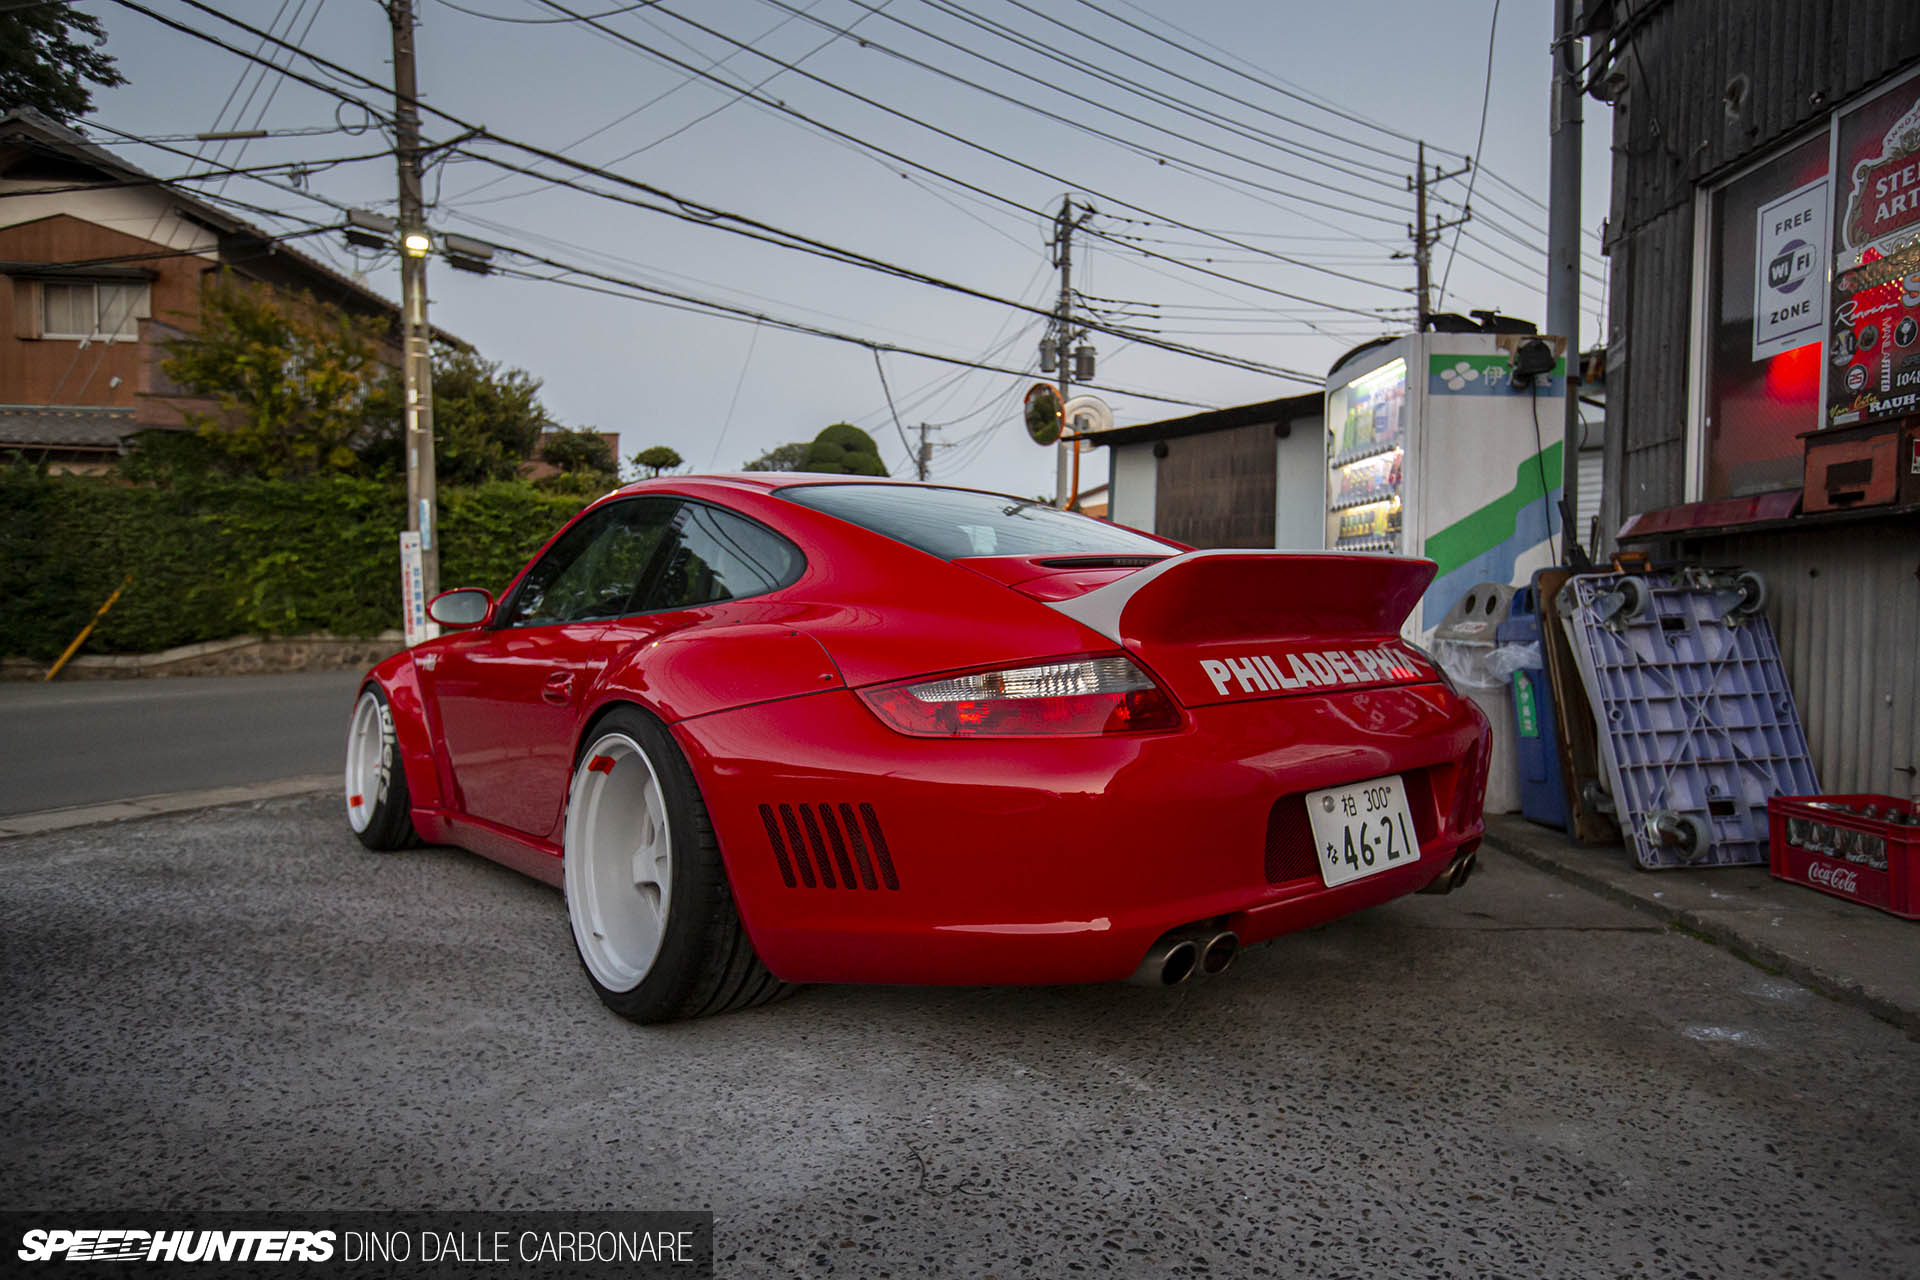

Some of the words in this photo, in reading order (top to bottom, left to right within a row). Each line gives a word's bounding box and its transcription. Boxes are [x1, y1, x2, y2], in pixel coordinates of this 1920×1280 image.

[1875, 162, 1920, 199] STE
[1775, 209, 1812, 236] FREE
[1770, 300, 1810, 325] ZONE
[1200, 648, 1423, 696] PHILADELPHIA
[1341, 794, 1357, 817] 柏
[1363, 787, 1388, 812] 300
[1326, 842, 1339, 865] な
[1344, 812, 1411, 871] 46-21
